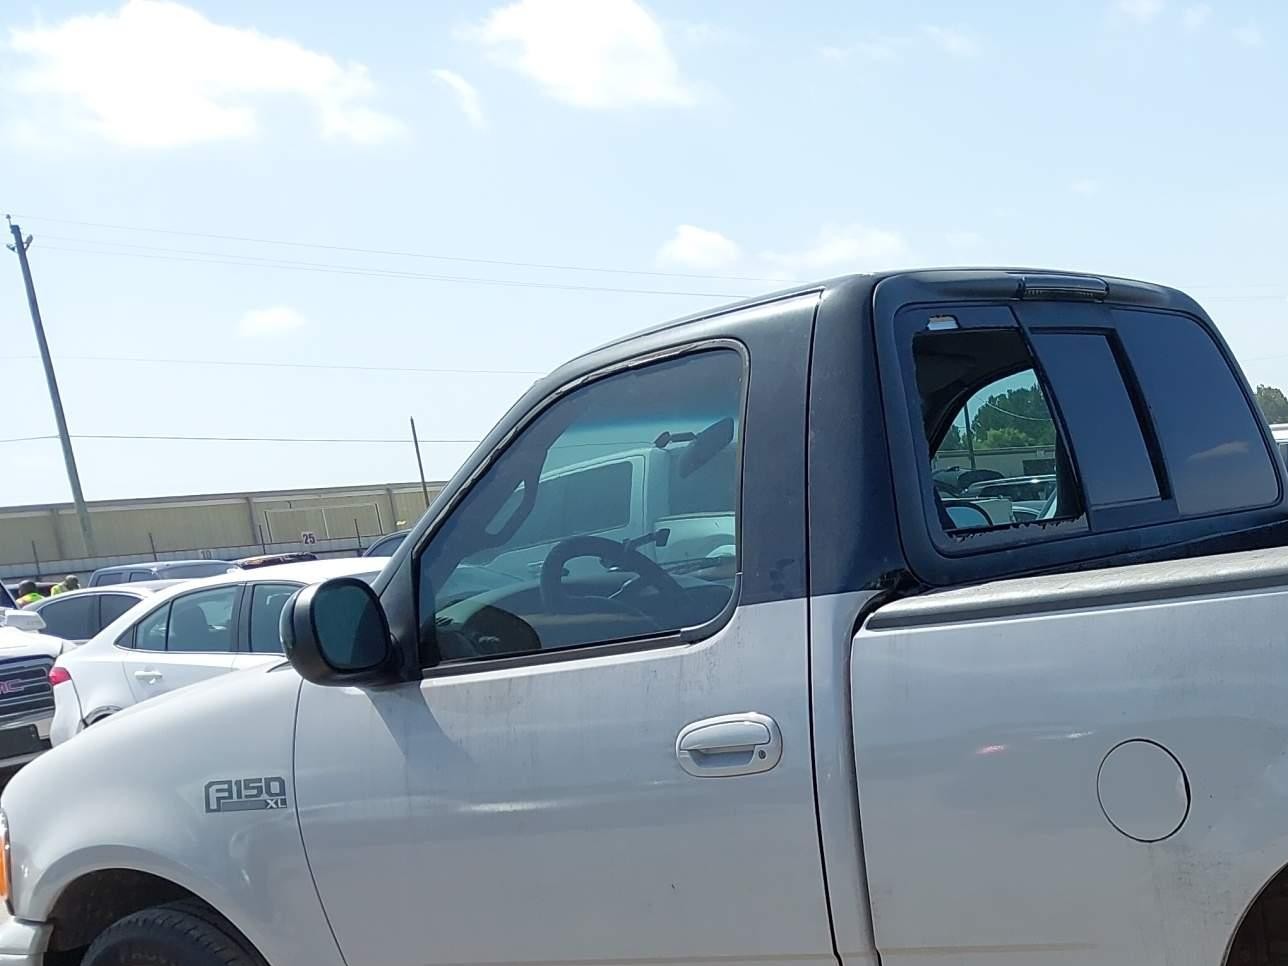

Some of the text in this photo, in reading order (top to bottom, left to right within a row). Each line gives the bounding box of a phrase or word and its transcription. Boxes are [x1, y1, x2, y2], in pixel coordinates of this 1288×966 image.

[303, 533, 316, 545] 25
[204, 776, 286, 813] F150
[265, 798, 287, 809] XL
